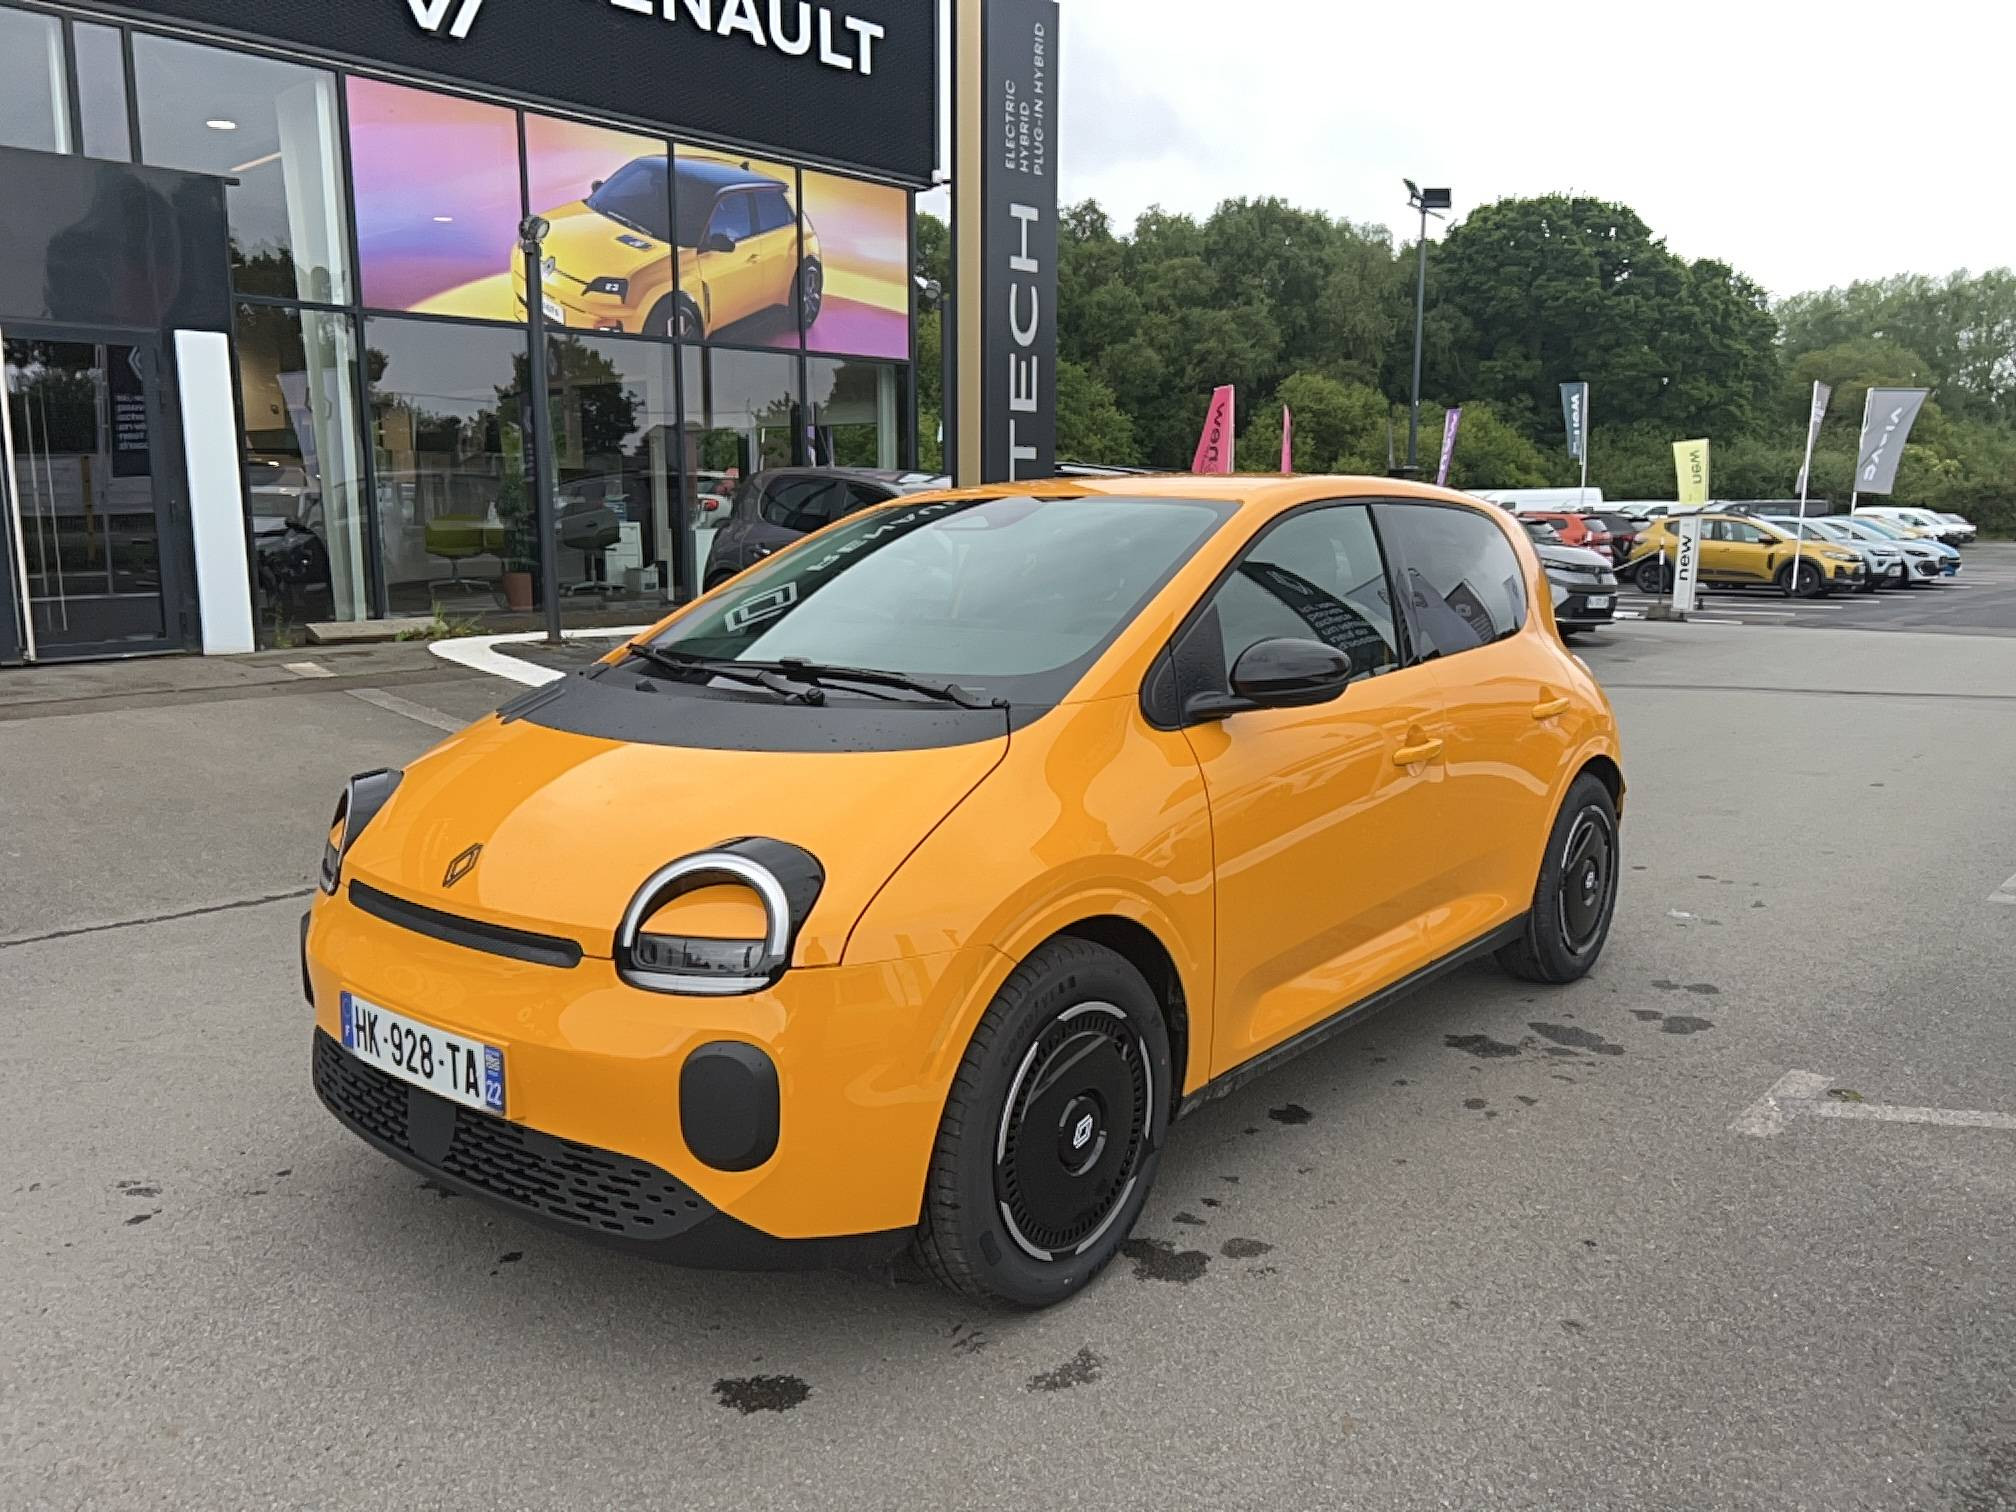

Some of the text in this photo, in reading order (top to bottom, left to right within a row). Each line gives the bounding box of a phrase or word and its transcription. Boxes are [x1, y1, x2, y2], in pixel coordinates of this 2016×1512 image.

[610, 0, 885, 75] AULT
[1005, 79, 1016, 169] ELECTRIC
[1033, 22, 1045, 176] PLUG-IN HYBRID
[1019, 101, 1030, 173] HYBRID
[1679, 535, 1692, 581] new
[355, 1005, 480, 1098] HK-928-TA
[487, 1080, 502, 1106] 22
